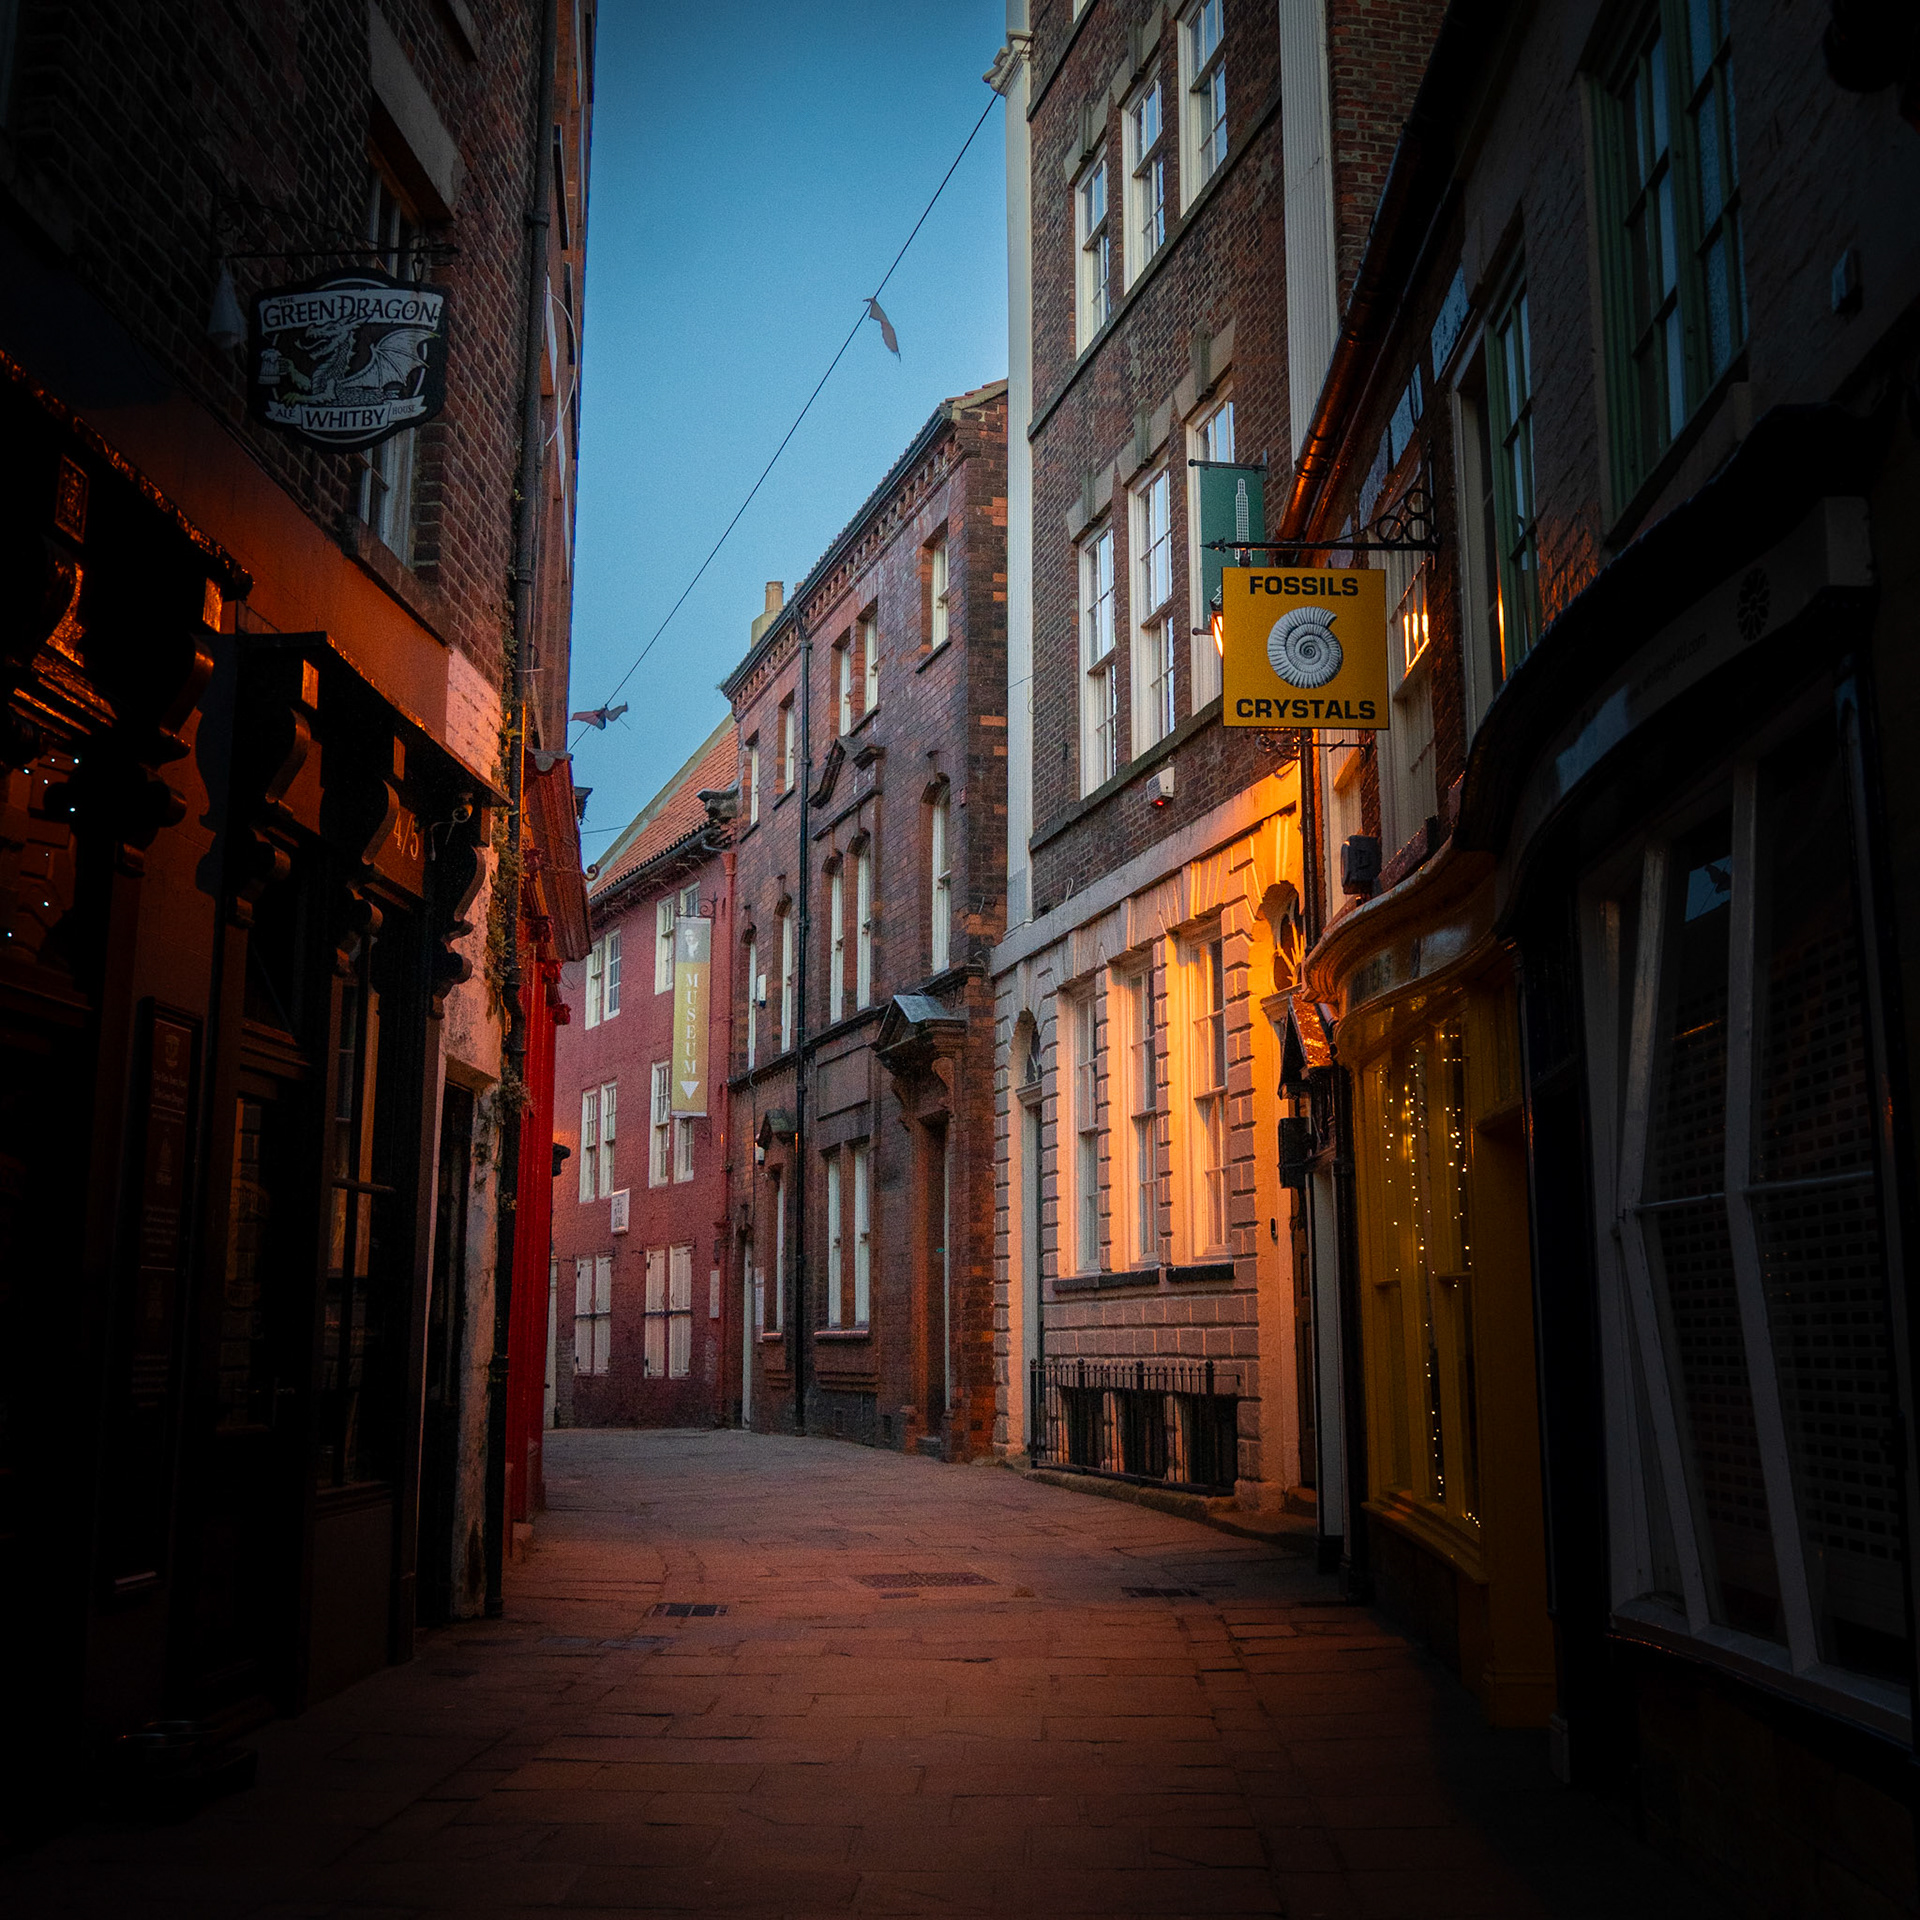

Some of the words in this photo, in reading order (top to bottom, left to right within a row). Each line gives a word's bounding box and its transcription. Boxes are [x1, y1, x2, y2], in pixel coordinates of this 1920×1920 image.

[263, 298, 335, 328] GREEN
[336, 295, 437, 324] DRAGON
[275, 408, 296, 421] ALE
[305, 408, 386, 429] WHITBY
[1249, 575, 1359, 597] FOSSILS
[1236, 698, 1376, 720] CRYSTALS
[684, 972, 700, 1075] MUSEUM
